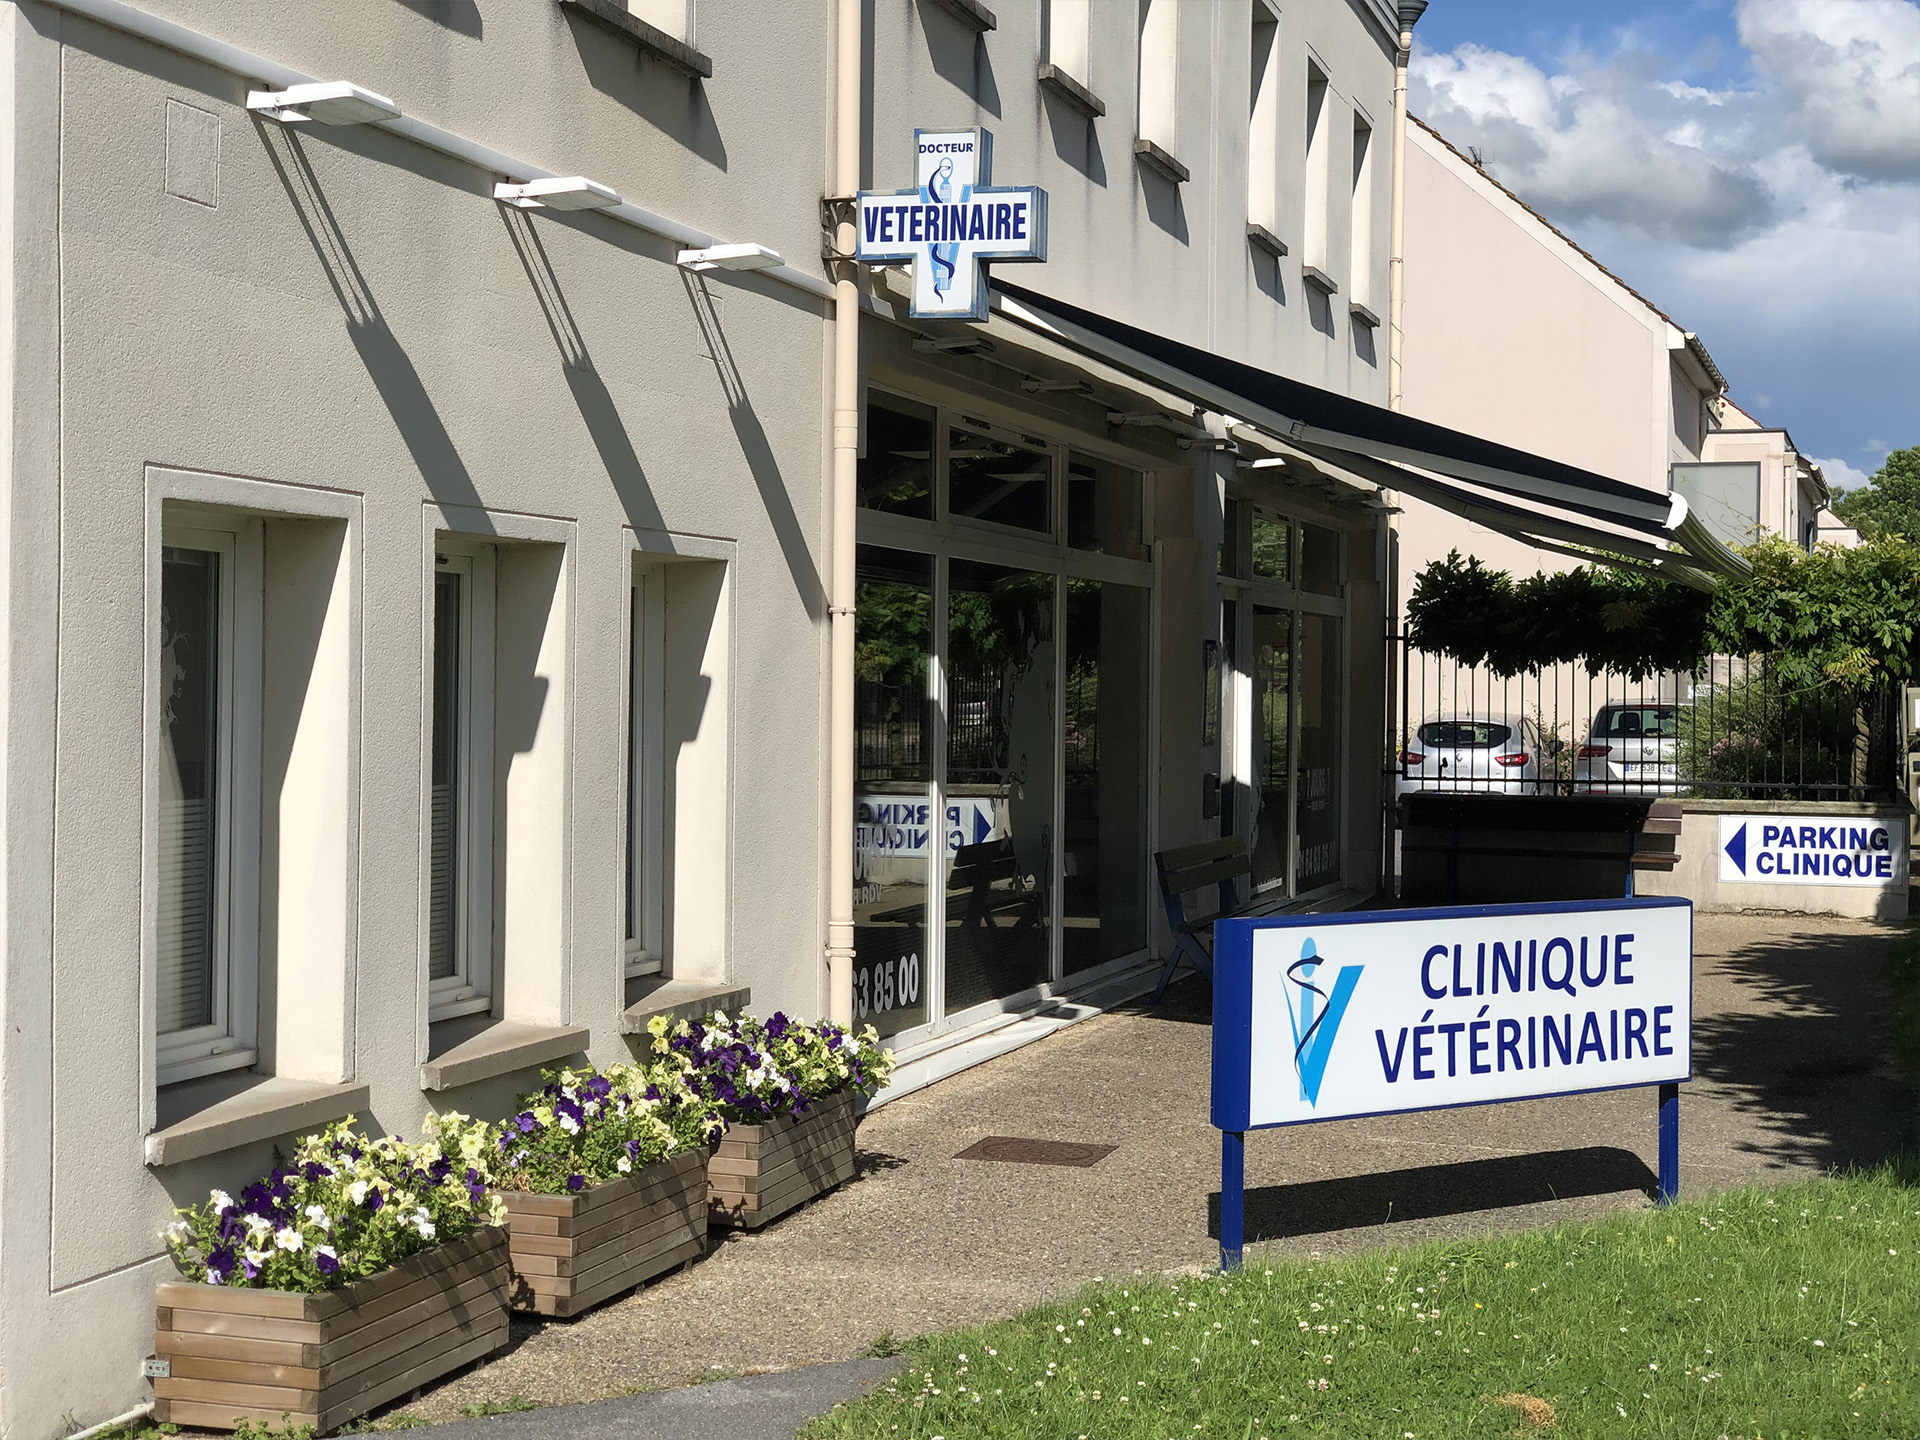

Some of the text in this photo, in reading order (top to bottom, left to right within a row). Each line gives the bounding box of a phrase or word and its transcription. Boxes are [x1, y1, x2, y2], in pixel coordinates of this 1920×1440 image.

[919, 142, 974, 154] DOCTEUR
[864, 202, 1027, 243] VETERINAIRE
[1762, 825, 1890, 851] PARKING
[1756, 852, 1893, 879] CLINIQUE
[874, 960, 894, 1014] 85
[898, 953, 919, 1006] 00
[1420, 933, 1635, 999] CLINIQUE
[1375, 1004, 1674, 1083] VÉTÉRINAIRE
